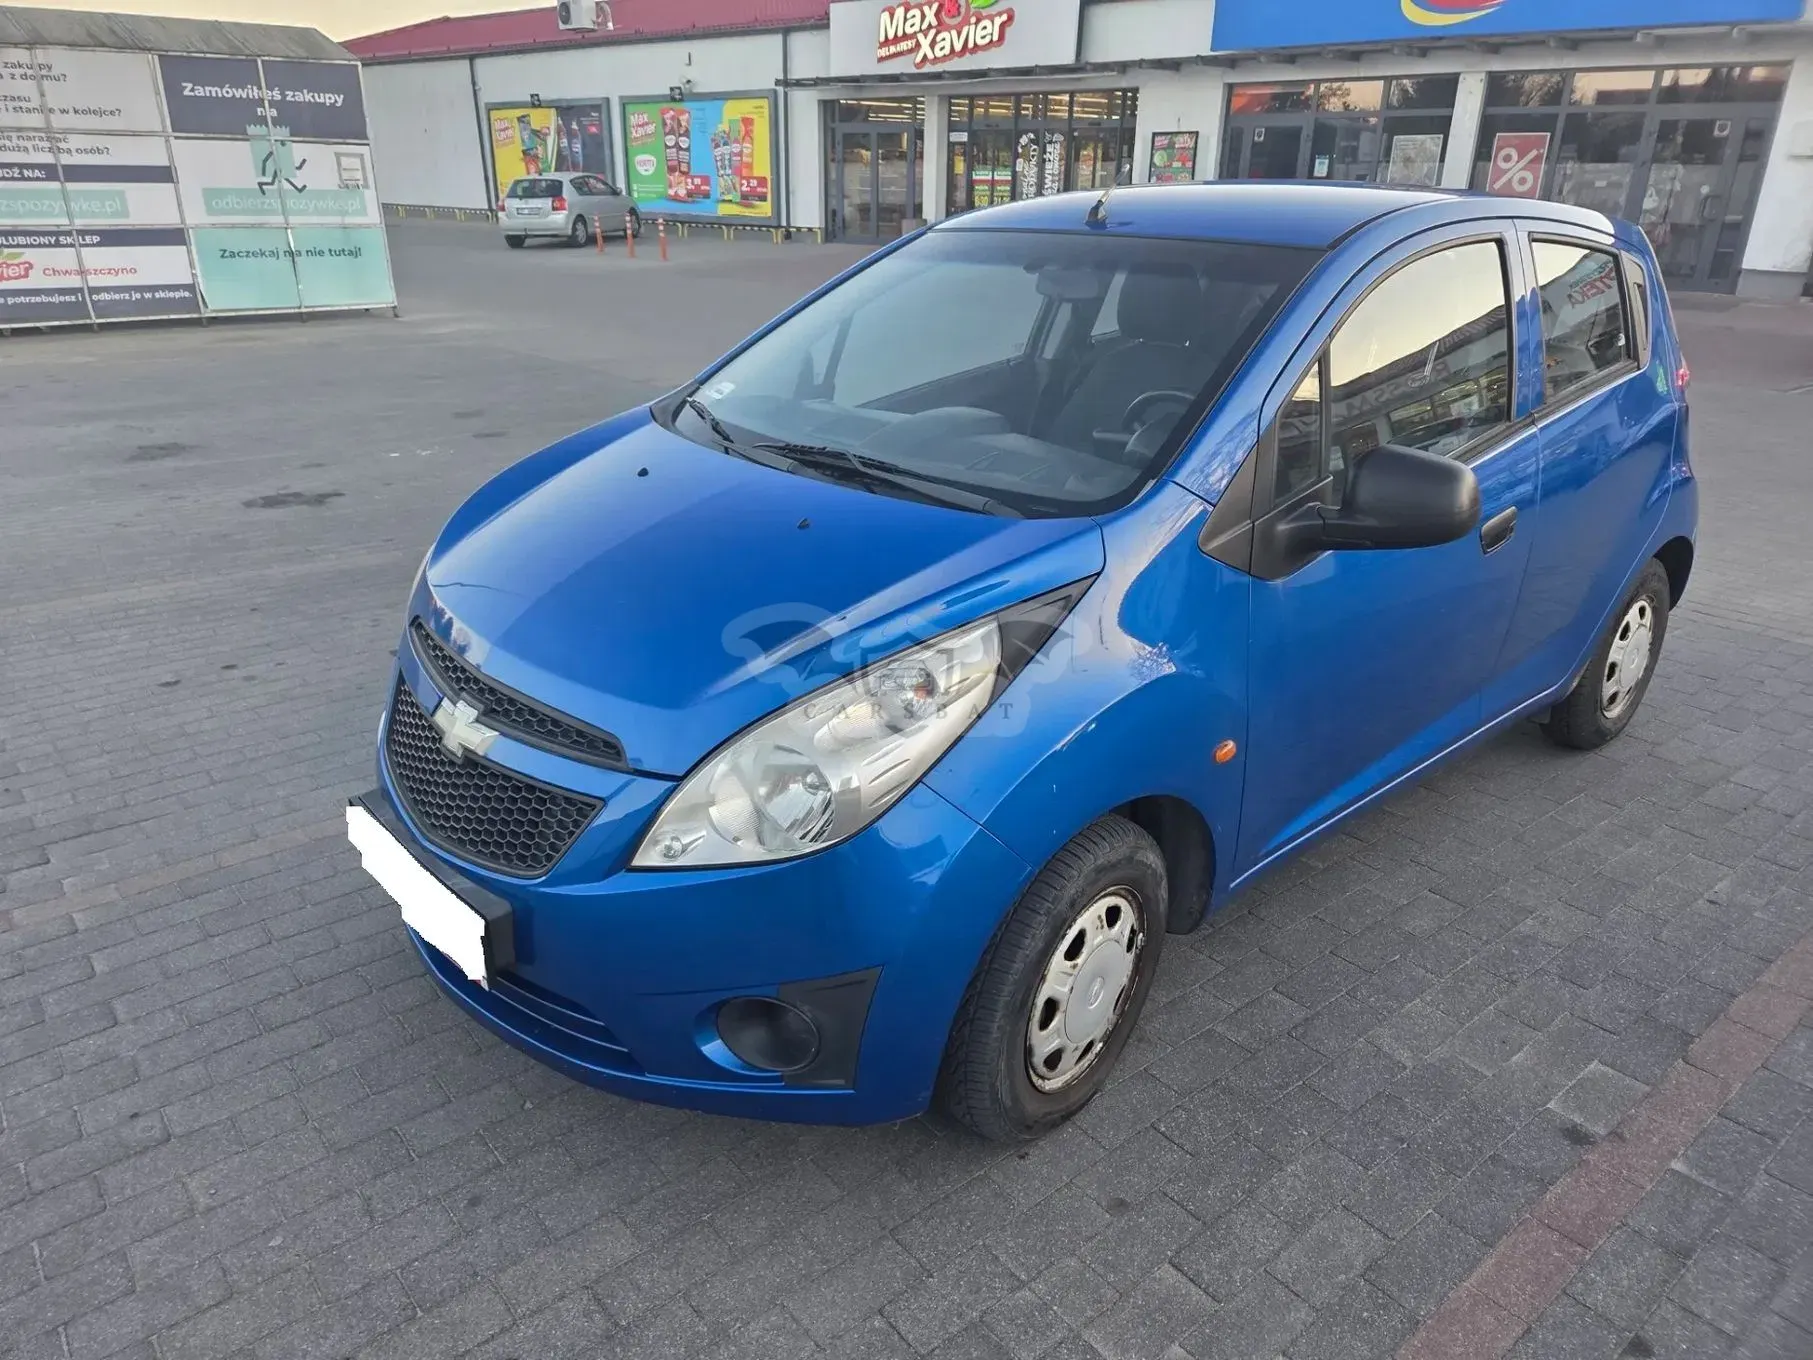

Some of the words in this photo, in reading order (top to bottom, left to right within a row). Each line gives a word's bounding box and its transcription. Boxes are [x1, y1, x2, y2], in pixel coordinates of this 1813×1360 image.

[879, 2, 939, 43] Max
[915, 13, 1008, 64] Xavier
[4, 60, 53, 72] zakupy
[20, 72, 67, 83] domu?
[181, 82, 283, 101] Zamówiłeś
[285, 89, 344, 107] zakupy
[73, 107, 122, 118] kolejce?
[256, 107, 279, 117] na
[59, 236, 101, 245] SKLEP
[219, 246, 280, 260] Zaczekaj
[306, 246, 325, 257] nie
[328, 246, 362, 259] tutaj!
[7, 293, 76, 305] potrzebujesz
[92, 290, 130, 302] odbierz
[131, 290, 142, 301] je
[143, 291, 152, 299] w
[154, 288, 193, 300] sklepie.
